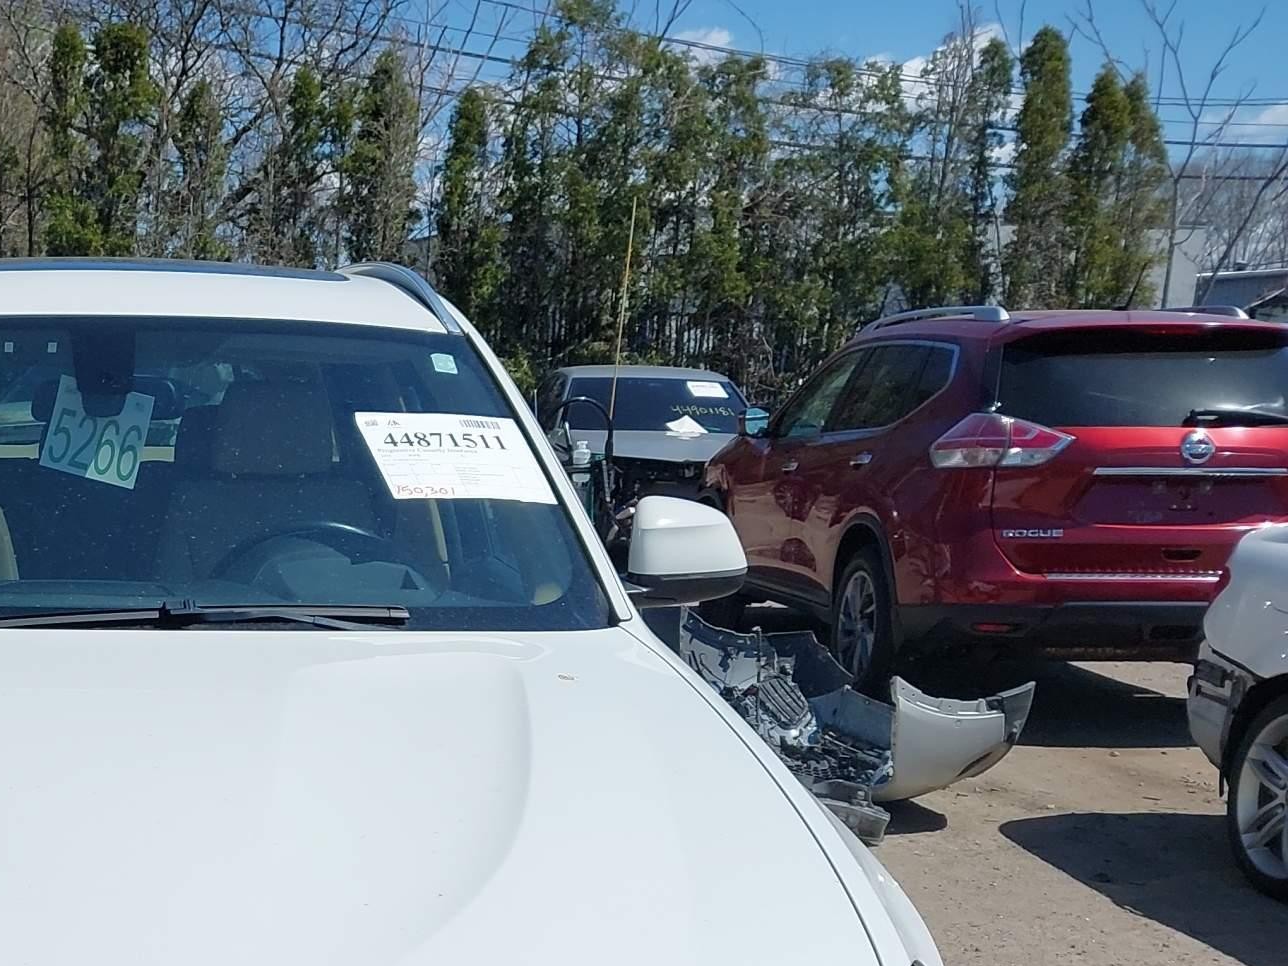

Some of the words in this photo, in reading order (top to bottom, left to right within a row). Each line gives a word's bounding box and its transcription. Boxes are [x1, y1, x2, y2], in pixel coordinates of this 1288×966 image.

[48, 407, 143, 481] 5266
[383, 432, 507, 450] 44871511
[1002, 529, 1064, 537] ROGUE
